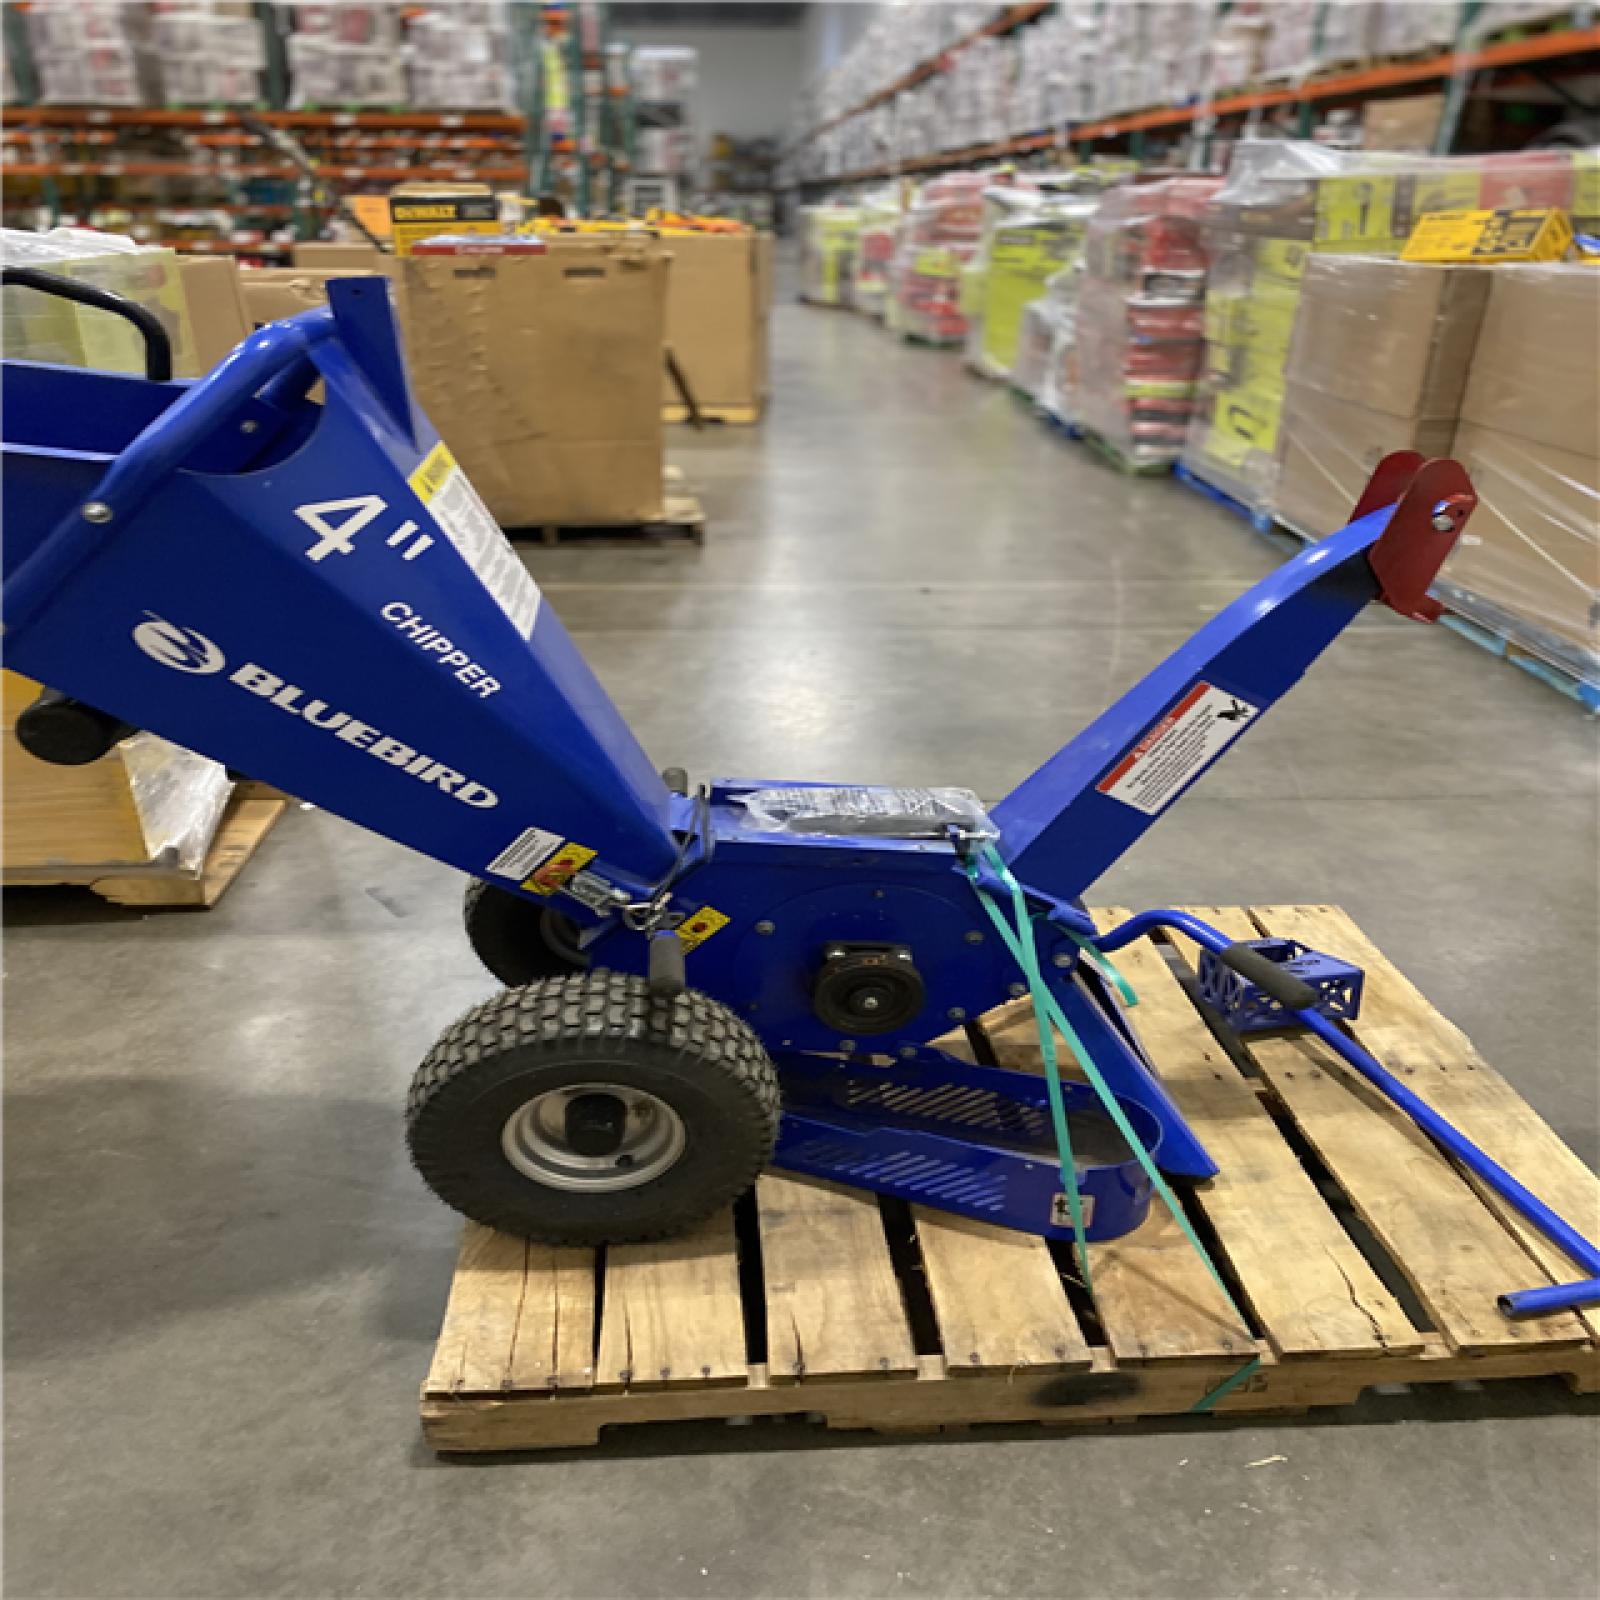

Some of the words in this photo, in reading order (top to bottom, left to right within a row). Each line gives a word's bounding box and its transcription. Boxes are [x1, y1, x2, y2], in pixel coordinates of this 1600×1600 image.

[294, 494, 435, 561] 4"
[381, 602, 501, 699] CHIPPER
[229, 649, 498, 809] BLUEBIRD
